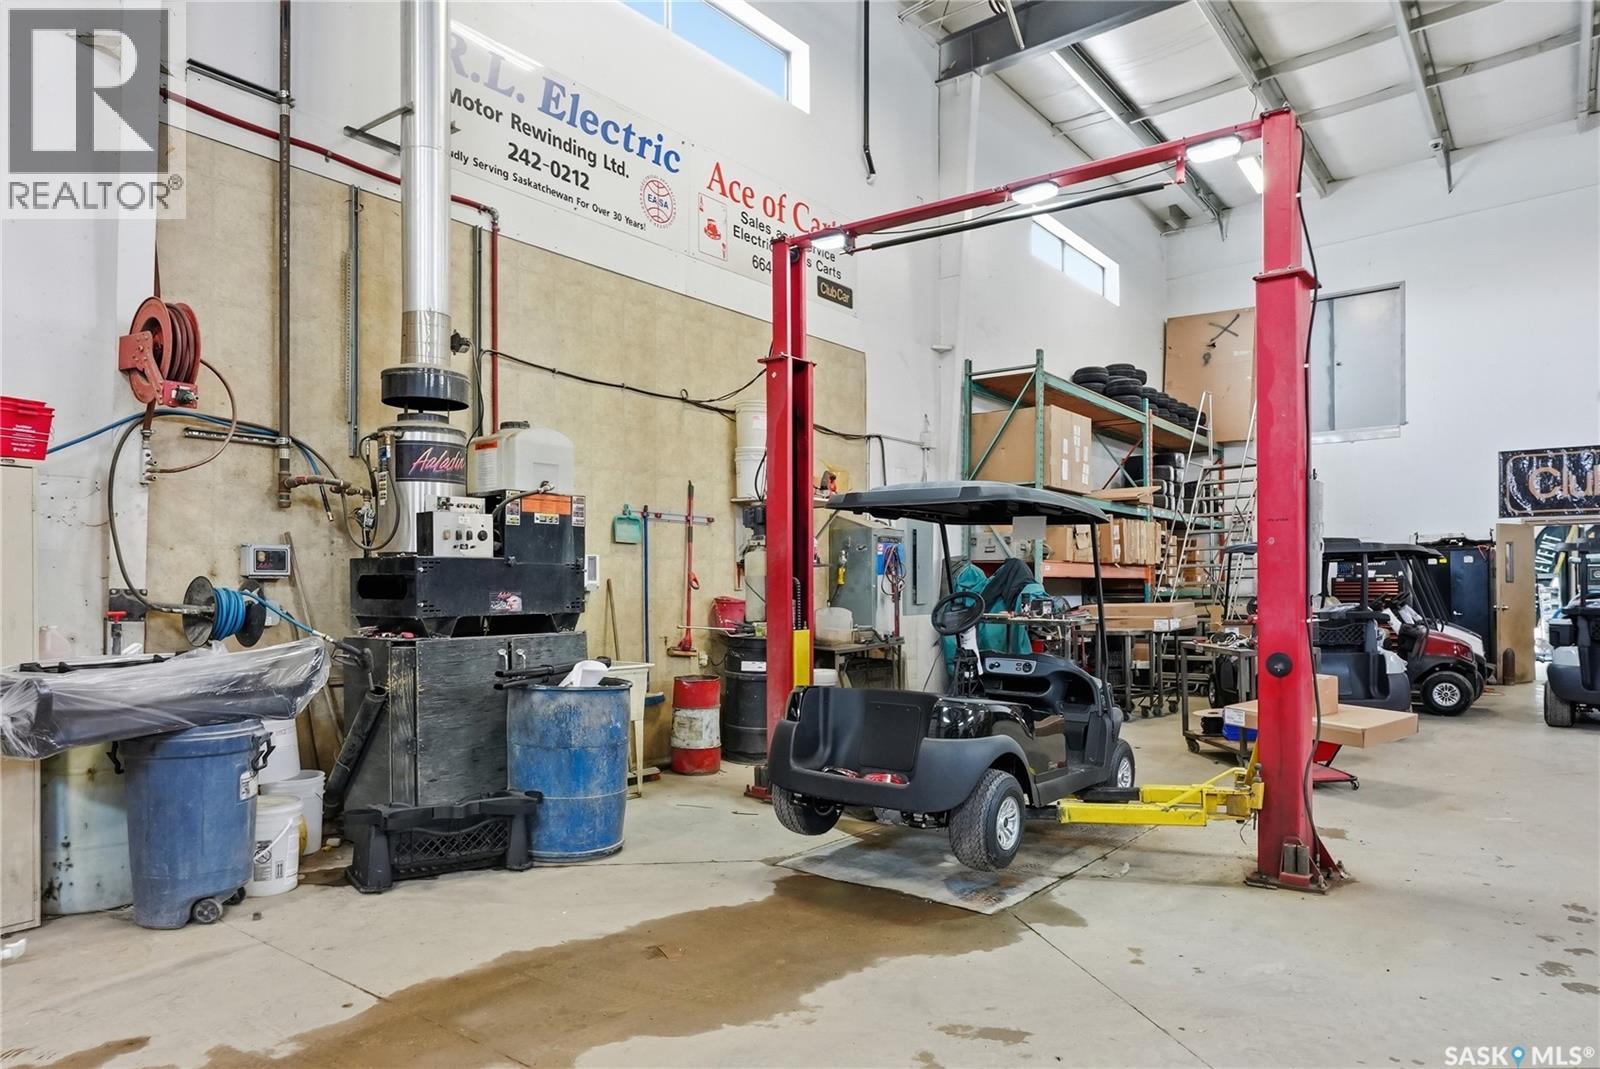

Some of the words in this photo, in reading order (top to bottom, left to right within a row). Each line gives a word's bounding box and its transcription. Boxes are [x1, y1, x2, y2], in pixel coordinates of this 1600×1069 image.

[510, 112, 597, 168] Rewinding
[603, 154, 630, 179] Ltd.
[537, 76, 681, 173] Electric
[472, 157, 509, 181] Serving
[512, 172, 574, 204] Saskatchewan
[576, 197, 590, 209] For
[592, 203, 610, 217] Over
[613, 211, 622, 221] 30
[624, 215, 646, 231] Years!
[507, 142, 590, 191] 242-0212
[706, 161, 755, 209] Ace
[762, 193, 787, 224] of
[647, 193, 669, 210] EASA
[740, 211, 771, 235] Sales
[816, 260, 842, 280] Carts
